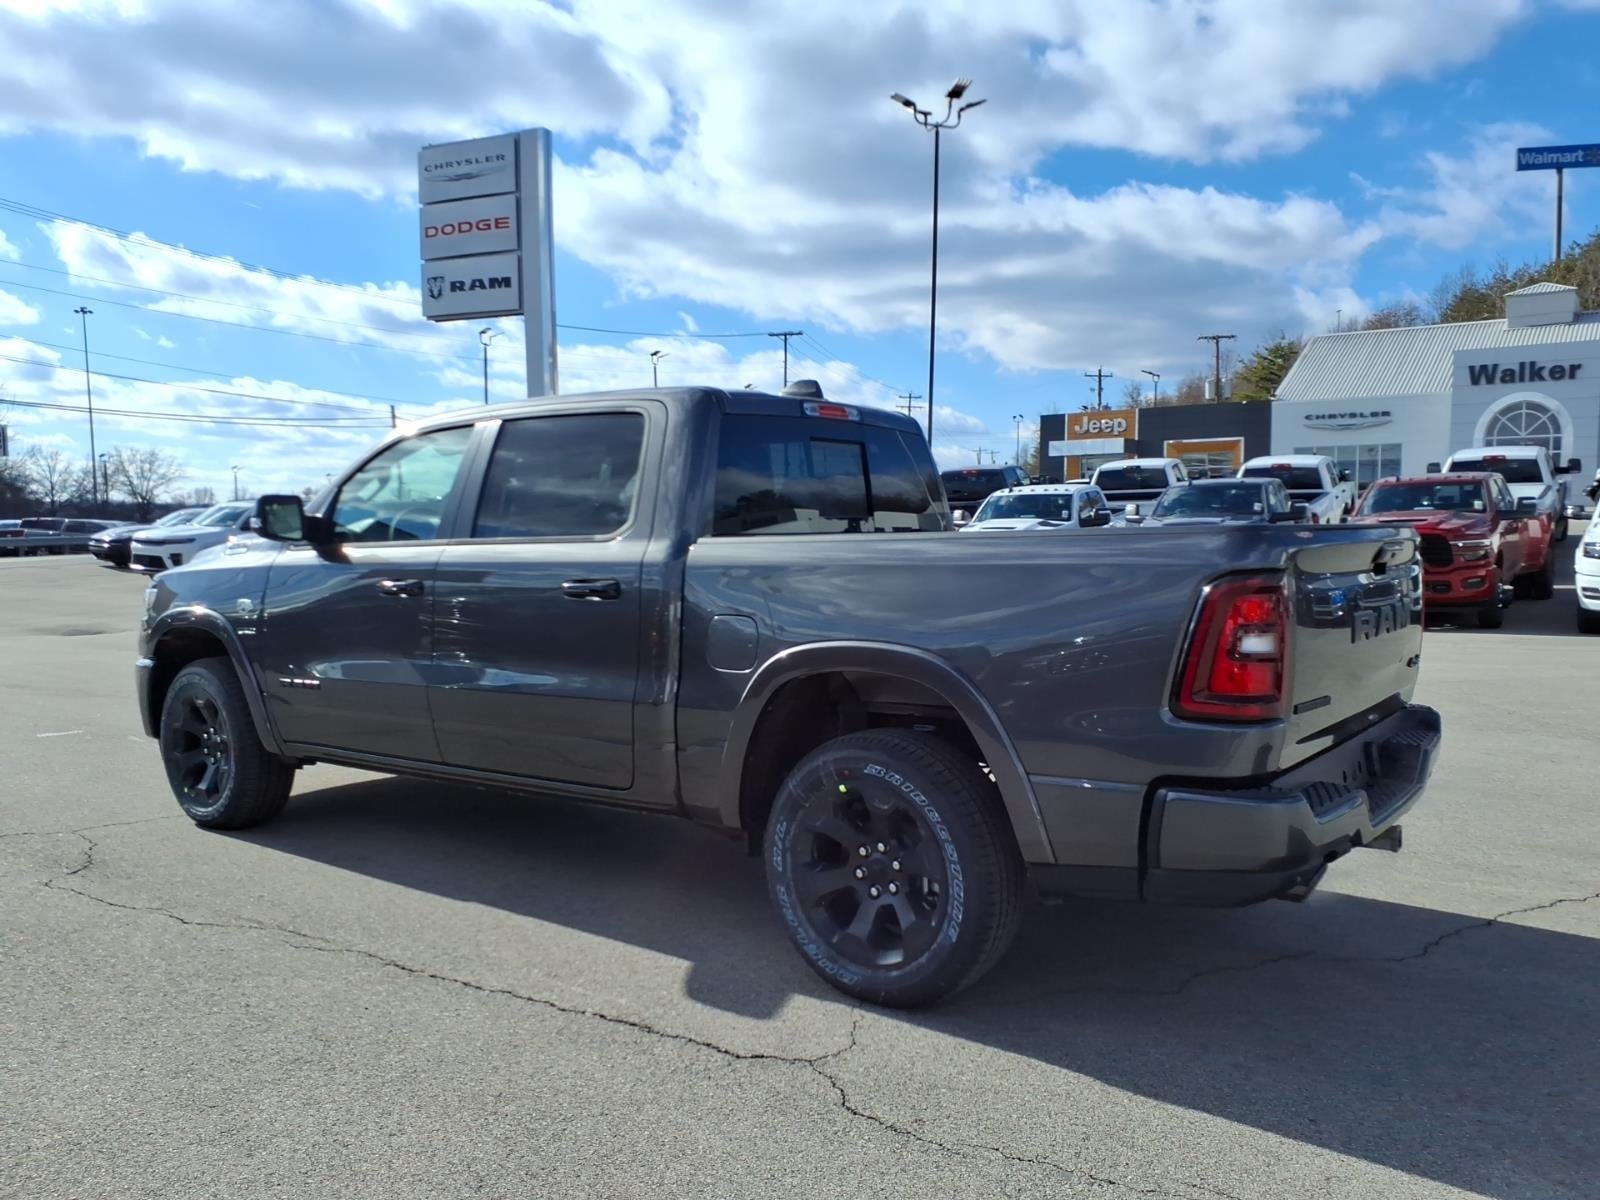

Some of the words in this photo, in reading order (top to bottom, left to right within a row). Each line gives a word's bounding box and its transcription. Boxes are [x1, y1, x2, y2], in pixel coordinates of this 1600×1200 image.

[424, 153, 506, 173] CHRYSLER
[1520, 150, 1584, 165] Walmart
[425, 217, 510, 239] DODGE
[450, 276, 512, 293] RAM
[1468, 360, 1583, 386] Walker
[1074, 416, 1128, 435] Jeep
[1304, 411, 1392, 421] CHRYSLER
